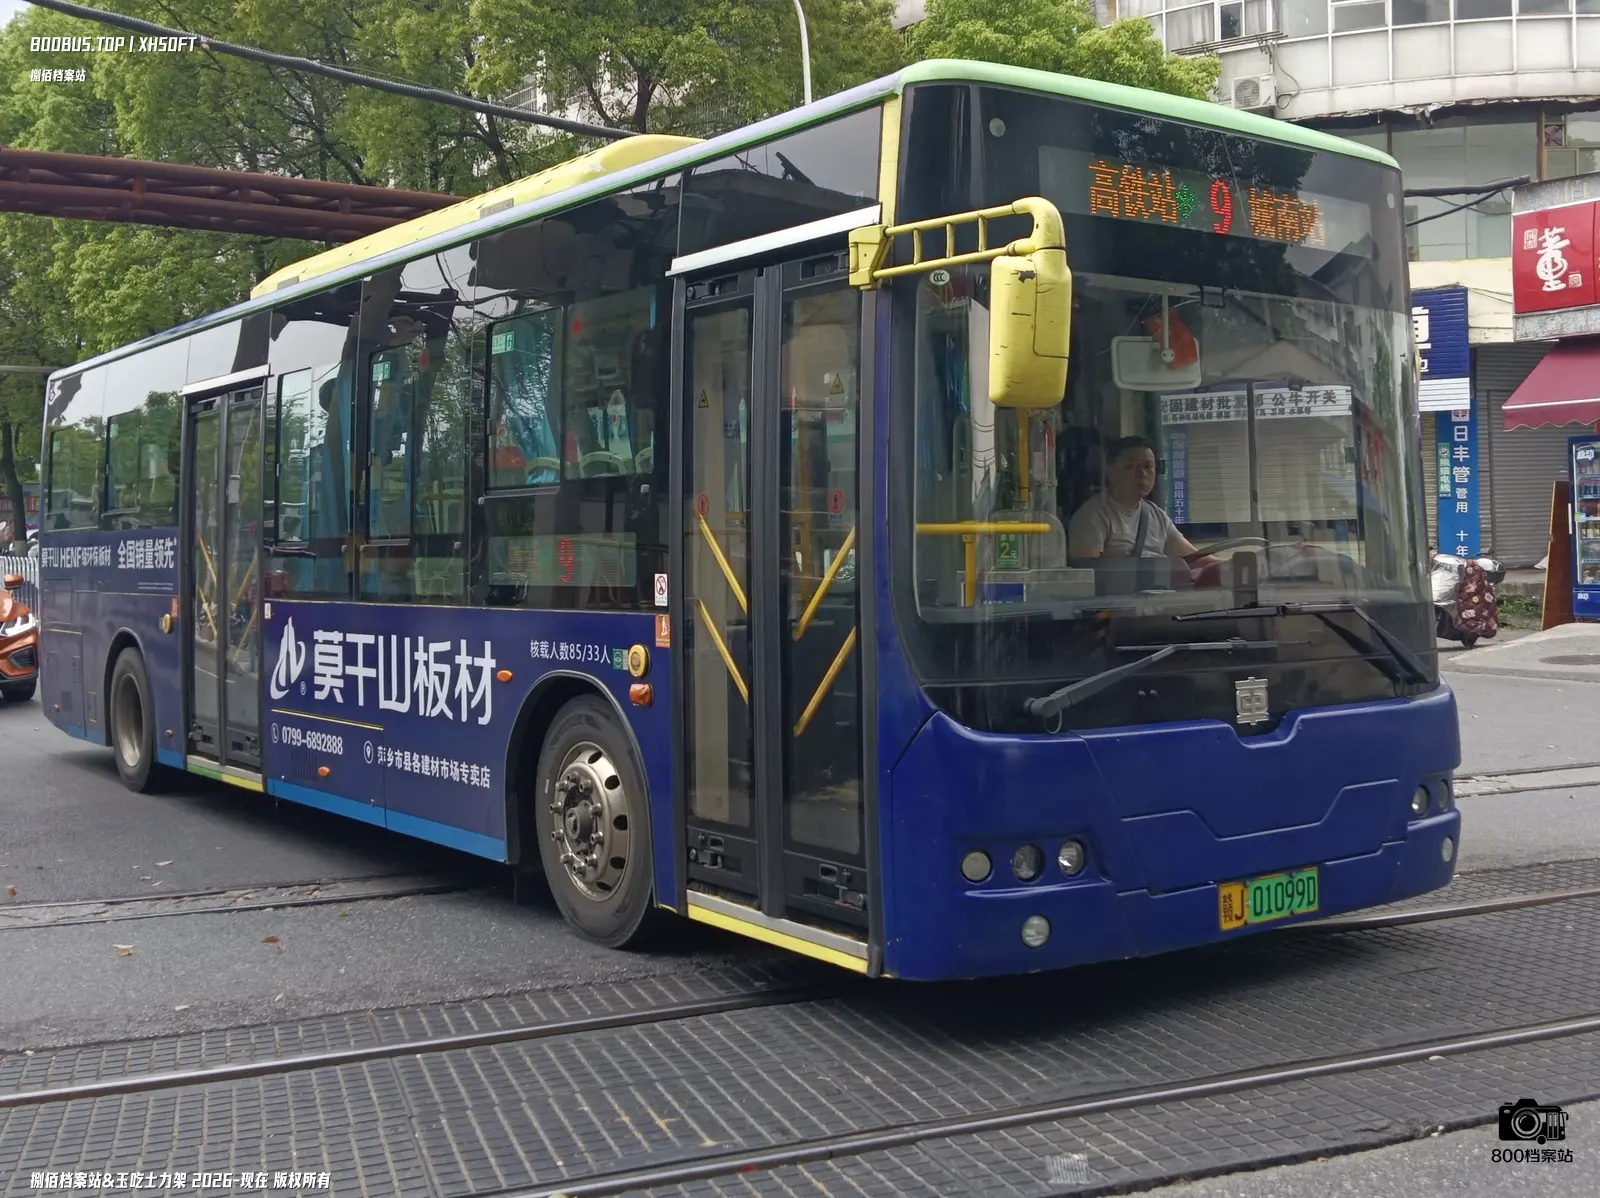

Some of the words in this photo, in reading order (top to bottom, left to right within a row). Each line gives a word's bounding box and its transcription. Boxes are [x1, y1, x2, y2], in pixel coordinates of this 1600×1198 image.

[1209, 179, 1233, 236] 9
[559, 537, 574, 584] 9
[530, 640, 611, 665] 核载人数85/33人
[313, 629, 496, 726] 莫干山板材
[282, 725, 343, 756] 0799-6892888
[377, 745, 491, 789] 萍乡市县各建材市场专卖店
